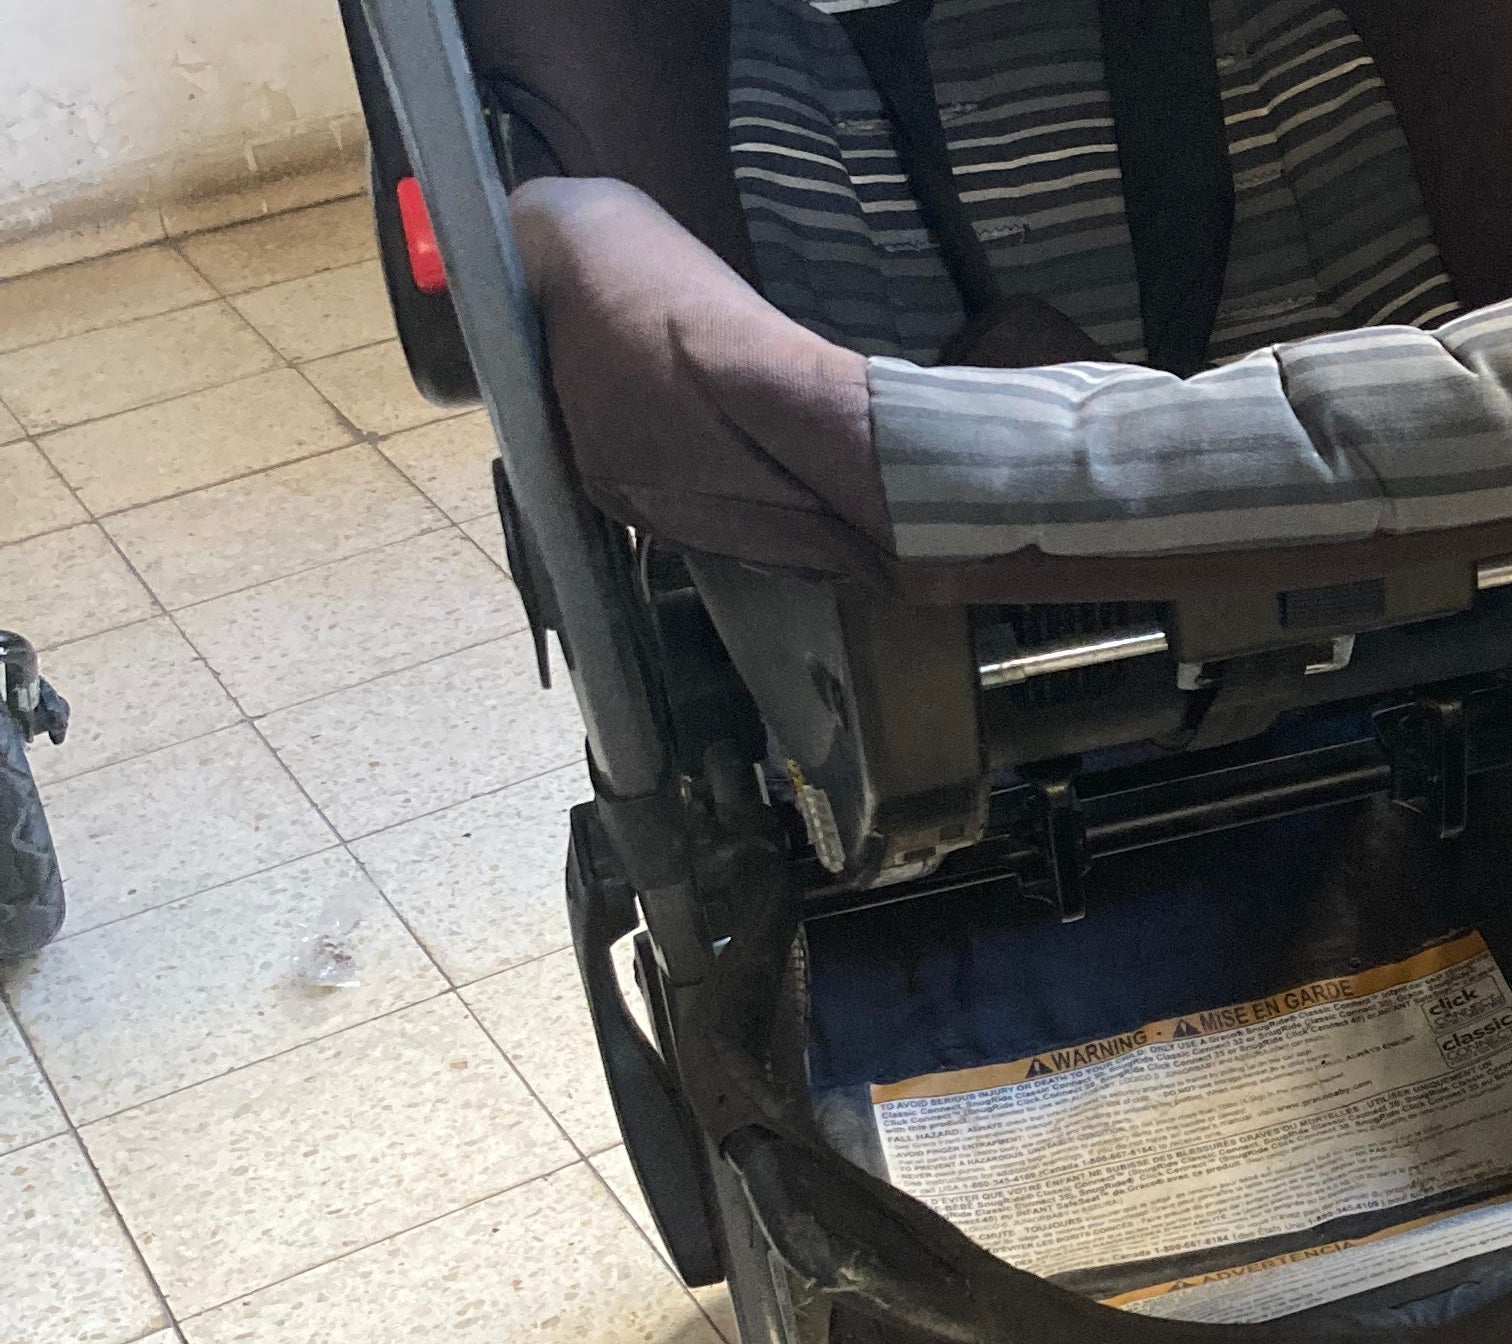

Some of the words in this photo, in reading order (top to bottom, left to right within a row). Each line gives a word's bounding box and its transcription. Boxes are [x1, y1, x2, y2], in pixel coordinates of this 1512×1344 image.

[1429, 988, 1478, 1015] click
[1051, 1030, 1148, 1071] WARNING
[1198, 1005, 1251, 1032] MISE
[1249, 996, 1280, 1019] EN
[1281, 978, 1355, 1010] GARDE
[1442, 1014, 1512, 1051] classic
[883, 1117, 908, 1127] Click
[1016, 1096, 1040, 1106] Click
[1146, 1061, 1170, 1071] Click
[895, 1099, 927, 1109] AVOID
[930, 1092, 976, 1105] SERIOUS
[977, 1085, 1014, 1098] INJURY
[1033, 1073, 1068, 1087] DEATH
[1085, 1060, 1112, 1074] YOUR
[1149, 1043, 1173, 1053] ONLY
[881, 1108, 916, 1120] Classic
[965, 1093, 1013, 1110] SnugRide
[1014, 1085, 1049, 1099] Classic
[887, 1134, 913, 1143] FALL
[895, 1149, 924, 1158] AVOID
[1007, 1182, 1042, 1196] VOTRE
[1045, 1172, 1085, 1188] ENFANT
[1238, 1126, 1280, 1144] GRAVES
[1024, 1216, 1082, 1233] TOUJOURS
